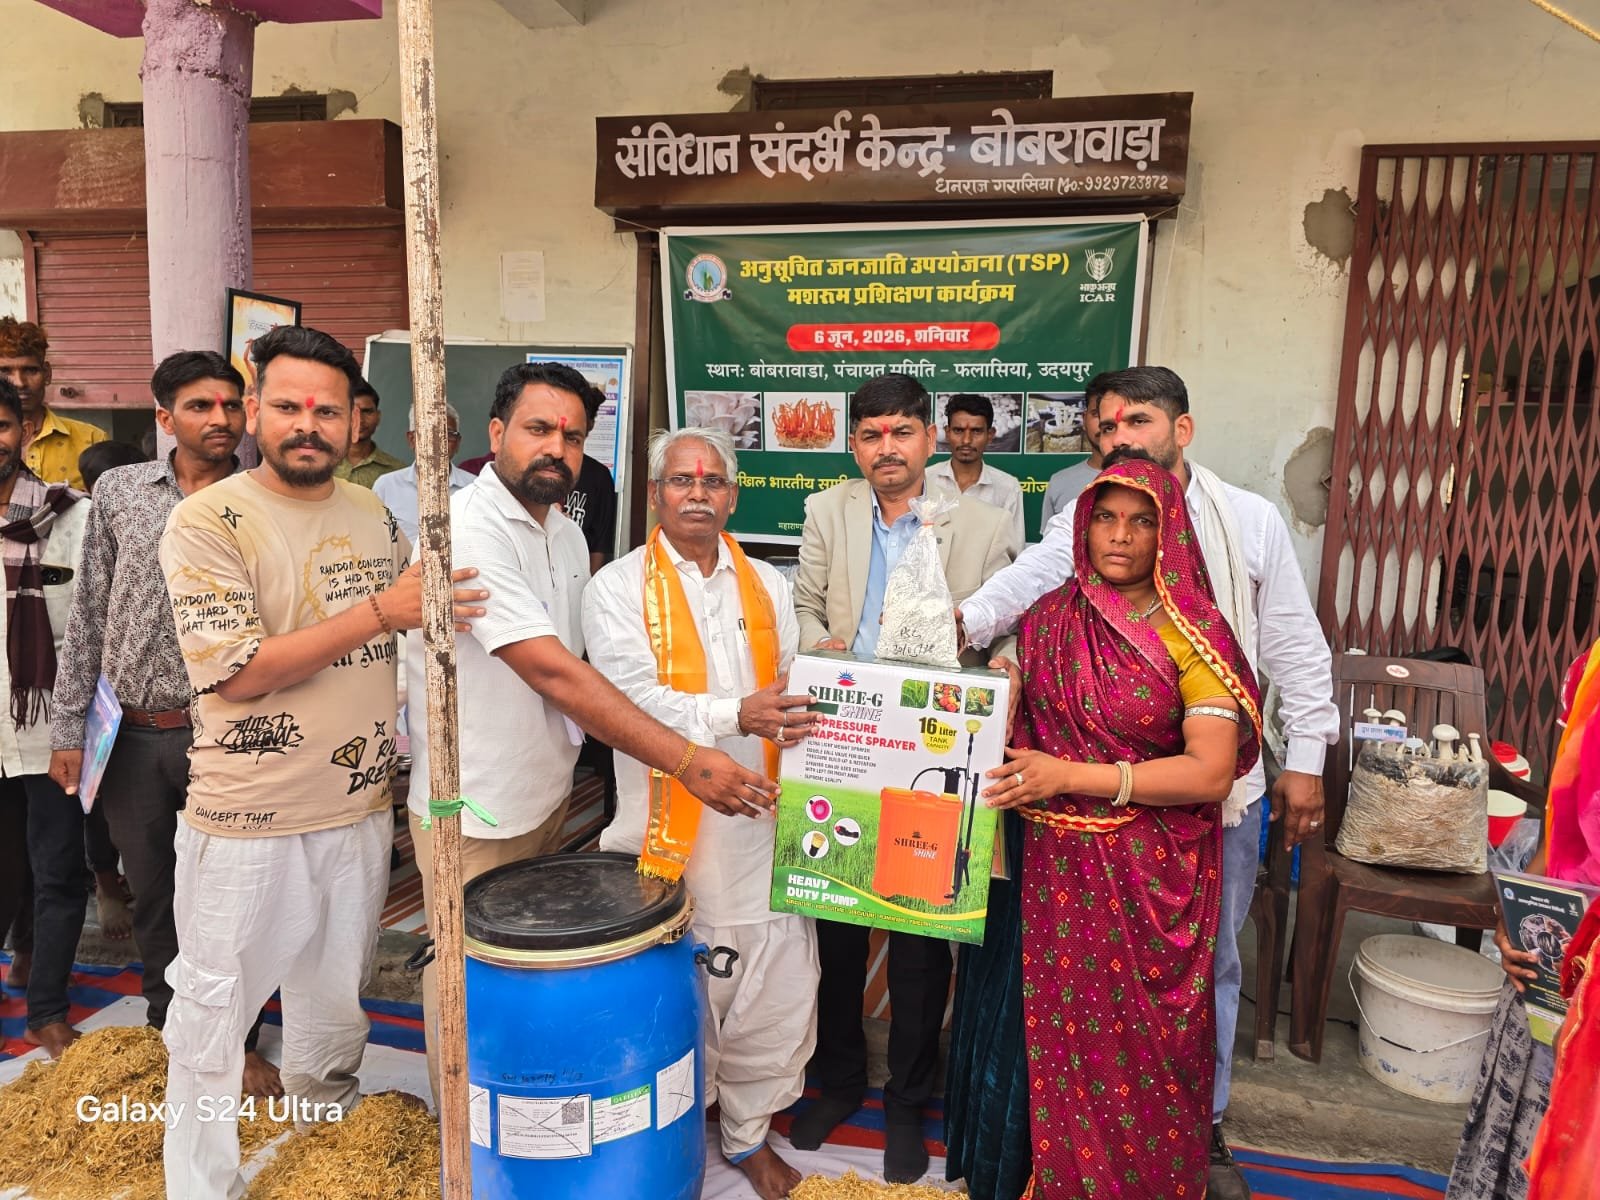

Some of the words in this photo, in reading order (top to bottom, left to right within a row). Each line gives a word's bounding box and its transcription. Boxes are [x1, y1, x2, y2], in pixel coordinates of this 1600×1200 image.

[615, 121, 741, 179] संविधान
[750, 110, 852, 181] संदर्भ
[969, 107, 1166, 171] बोबरावाड़ा
[935, 176, 990, 195] धनराज
[993, 172, 1054, 194] गरासिया
[740, 255, 824, 283] अनुसूचित
[826, 253, 907, 275] जनजाति
[910, 250, 1005, 274] उपयोजना
[1007, 253, 1070, 276] (TSP)
[787, 288, 851, 304] मशरूम
[854, 282, 934, 306] प्रशिक्षण
[936, 280, 1016, 304] कार्यक्रम
[1079, 293, 1116, 303] ICAR
[814, 331, 825, 344] 6
[827, 330, 859, 348] जून,
[863, 329, 911, 346] 2026,
[914, 326, 970, 343] शनिवार
[706, 363, 744, 378] स्थान:
[749, 359, 829, 380] बोबरावाडा,
[833, 360, 886, 378] पंचायत
[953, 358, 1032, 380] फलासिया,
[1037, 362, 1094, 382] उदयपुर
[736, 471, 766, 488] खिल
[769, 473, 815, 490] भारतीय
[328, 578, 339, 588] IS
[365, 571, 374, 581] TO
[173, 593, 216, 607] ANDOM
[197, 606, 229, 619] HARD
[233, 604, 247, 615] TO
[209, 619, 239, 631] THIS
[245, 617, 260, 627] ART
[808, 685, 883, 707] SHREE-G
[840, 704, 884, 722] SHINE
[919, 716, 937, 735] 16
[808, 729, 864, 745] NAPSACK
[865, 736, 917, 752] SPRAYER
[930, 736, 948, 744] TANK
[196, 806, 241, 822] CONCEPT
[244, 811, 277, 824] THAT
[894, 837, 938, 851] SHREE-G
[788, 874, 830, 889] HEAVY
[787, 886, 819, 900] DUTY
[822, 892, 858, 907] PUMP
